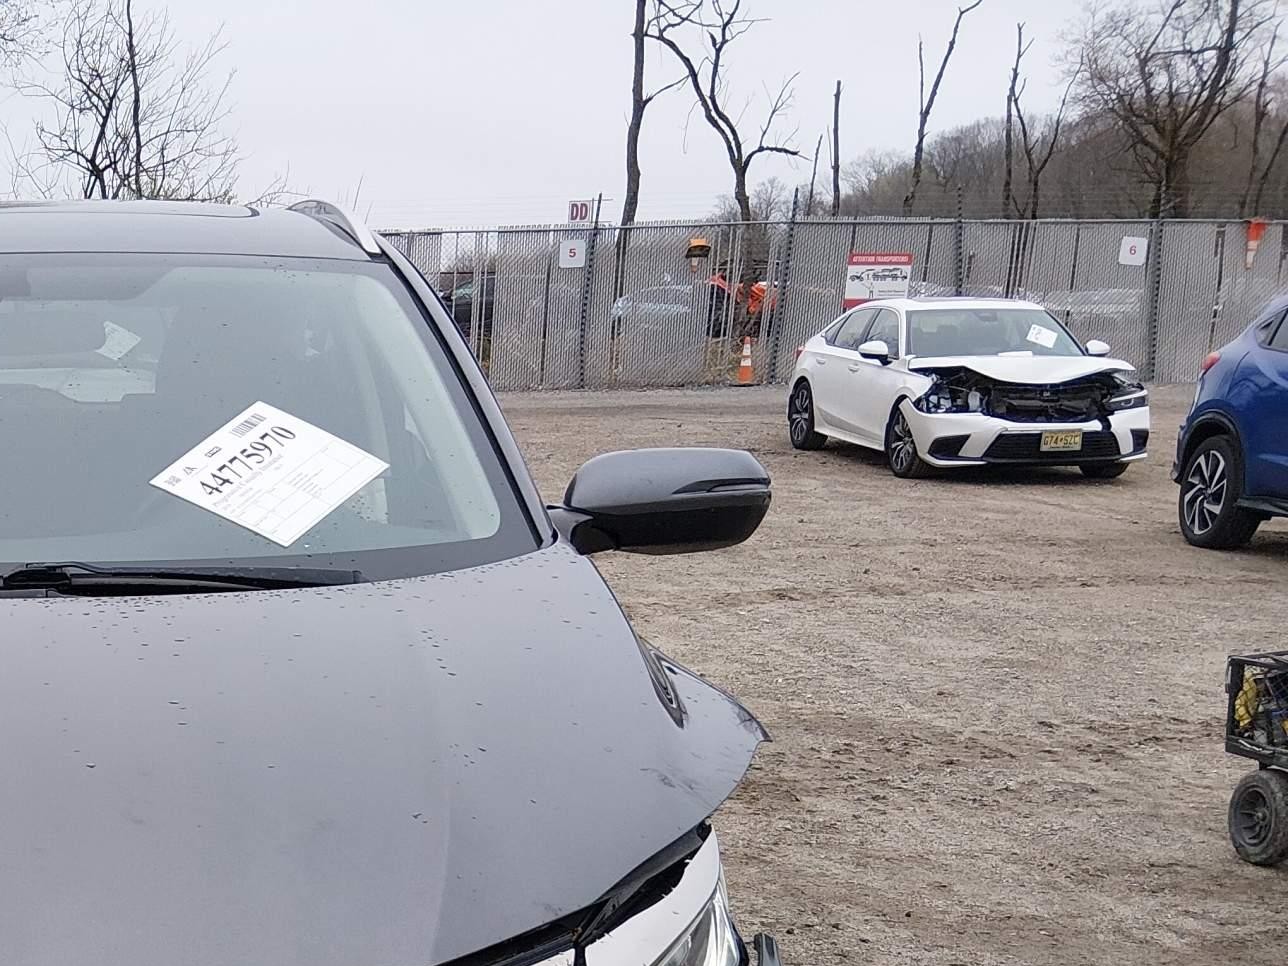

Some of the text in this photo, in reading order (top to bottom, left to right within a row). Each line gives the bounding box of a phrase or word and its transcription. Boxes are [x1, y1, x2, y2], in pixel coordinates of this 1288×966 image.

[570, 202, 588, 220] DD
[569, 248, 576, 257] 5
[1129, 245, 1137, 255] 6
[199, 426, 296, 496] 44775970
